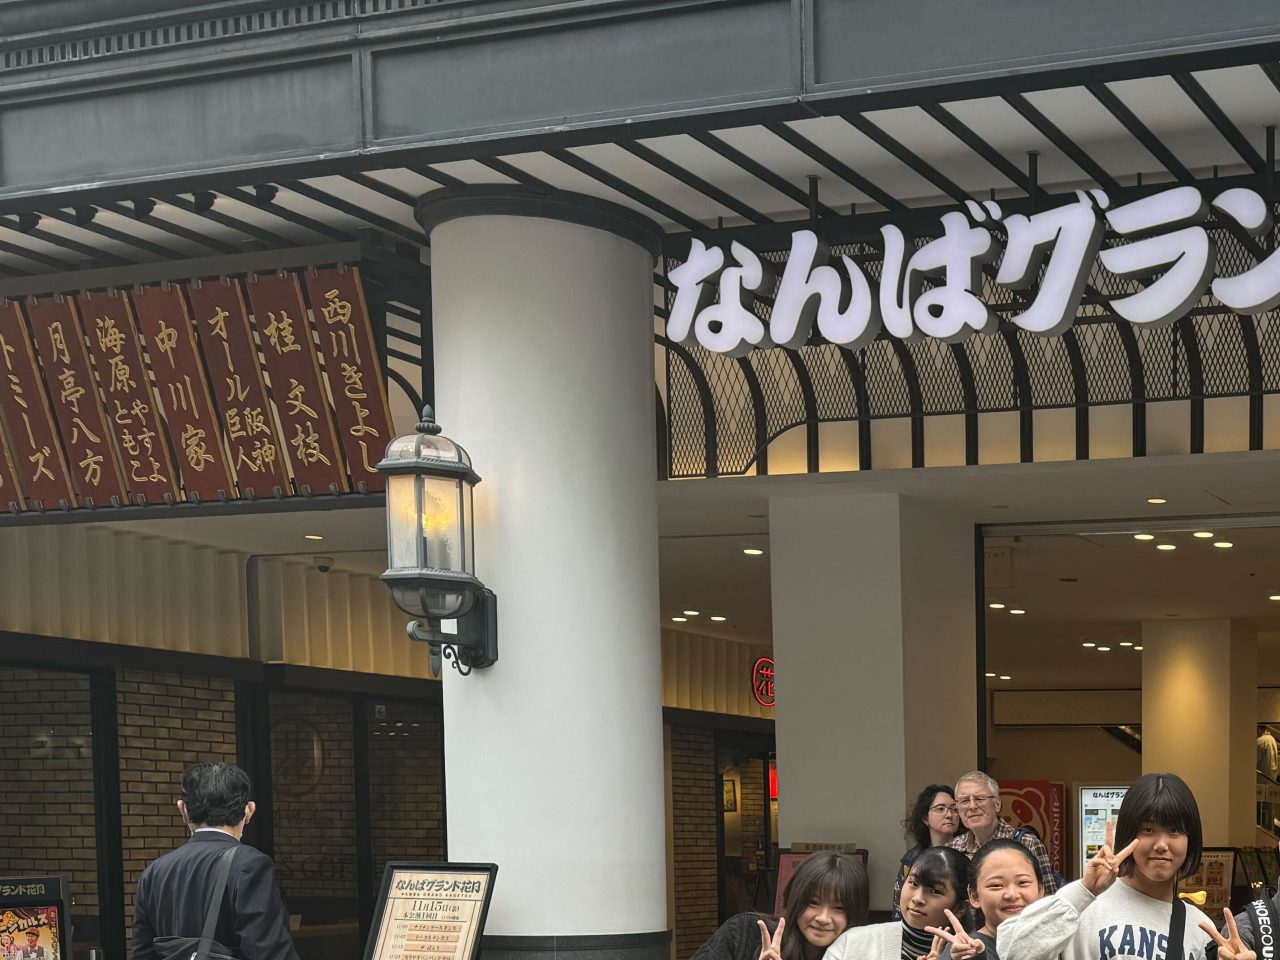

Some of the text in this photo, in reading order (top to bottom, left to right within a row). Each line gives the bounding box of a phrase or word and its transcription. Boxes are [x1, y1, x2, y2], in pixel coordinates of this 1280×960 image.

[0, 333, 55, 482] トミーズ
[48, 320, 105, 487] 月亭八方
[153, 320, 215, 472] 中川家
[320, 289, 382, 474] 西川きよし
[395, 878, 482, 894] なんばグランド花月
